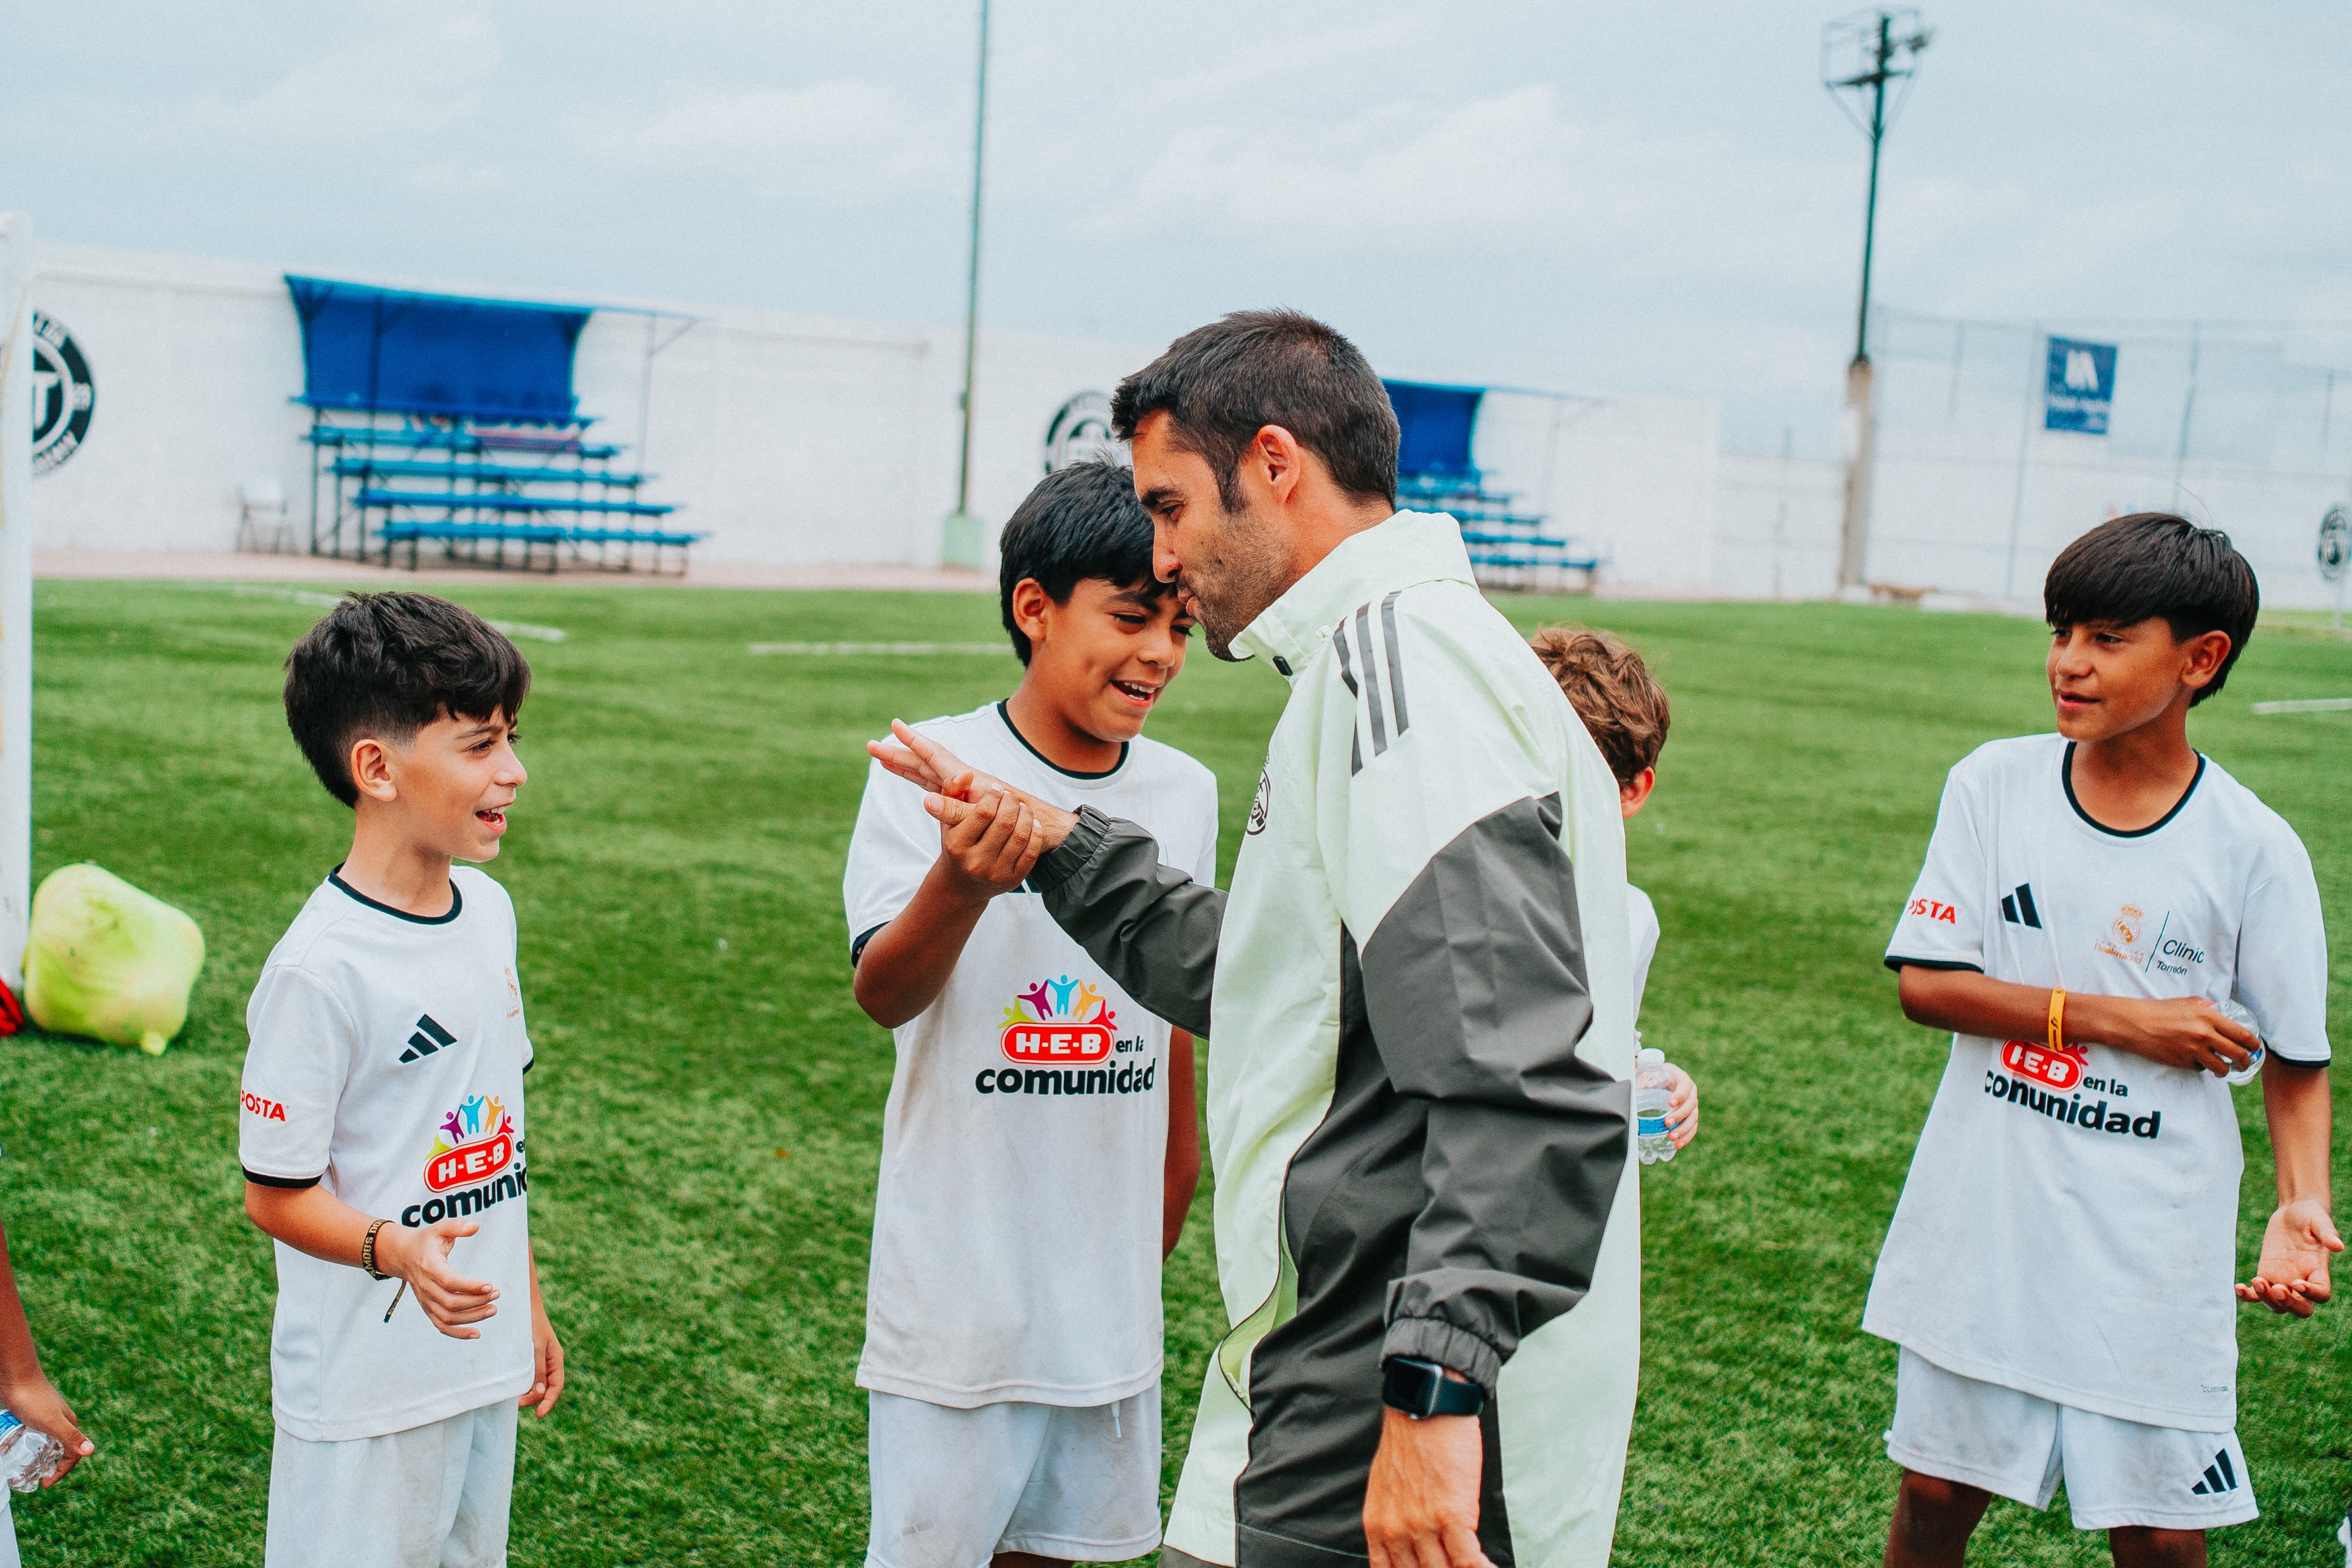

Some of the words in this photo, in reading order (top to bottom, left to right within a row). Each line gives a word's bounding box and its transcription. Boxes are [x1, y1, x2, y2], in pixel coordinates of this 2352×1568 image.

[2163, 939, 2204, 963] Clinic
[2157, 960, 2187, 976] Torreón
[1016, 1033, 1102, 1054] H-E-B
[1116, 1039, 1132, 1053] en
[975, 1058, 1156, 1095] comunidad
[2083, 1076, 2106, 1092] en
[2109, 1078, 2129, 1097] la
[438, 1141, 505, 1183] H-E-B
[516, 1139, 525, 1153] e
